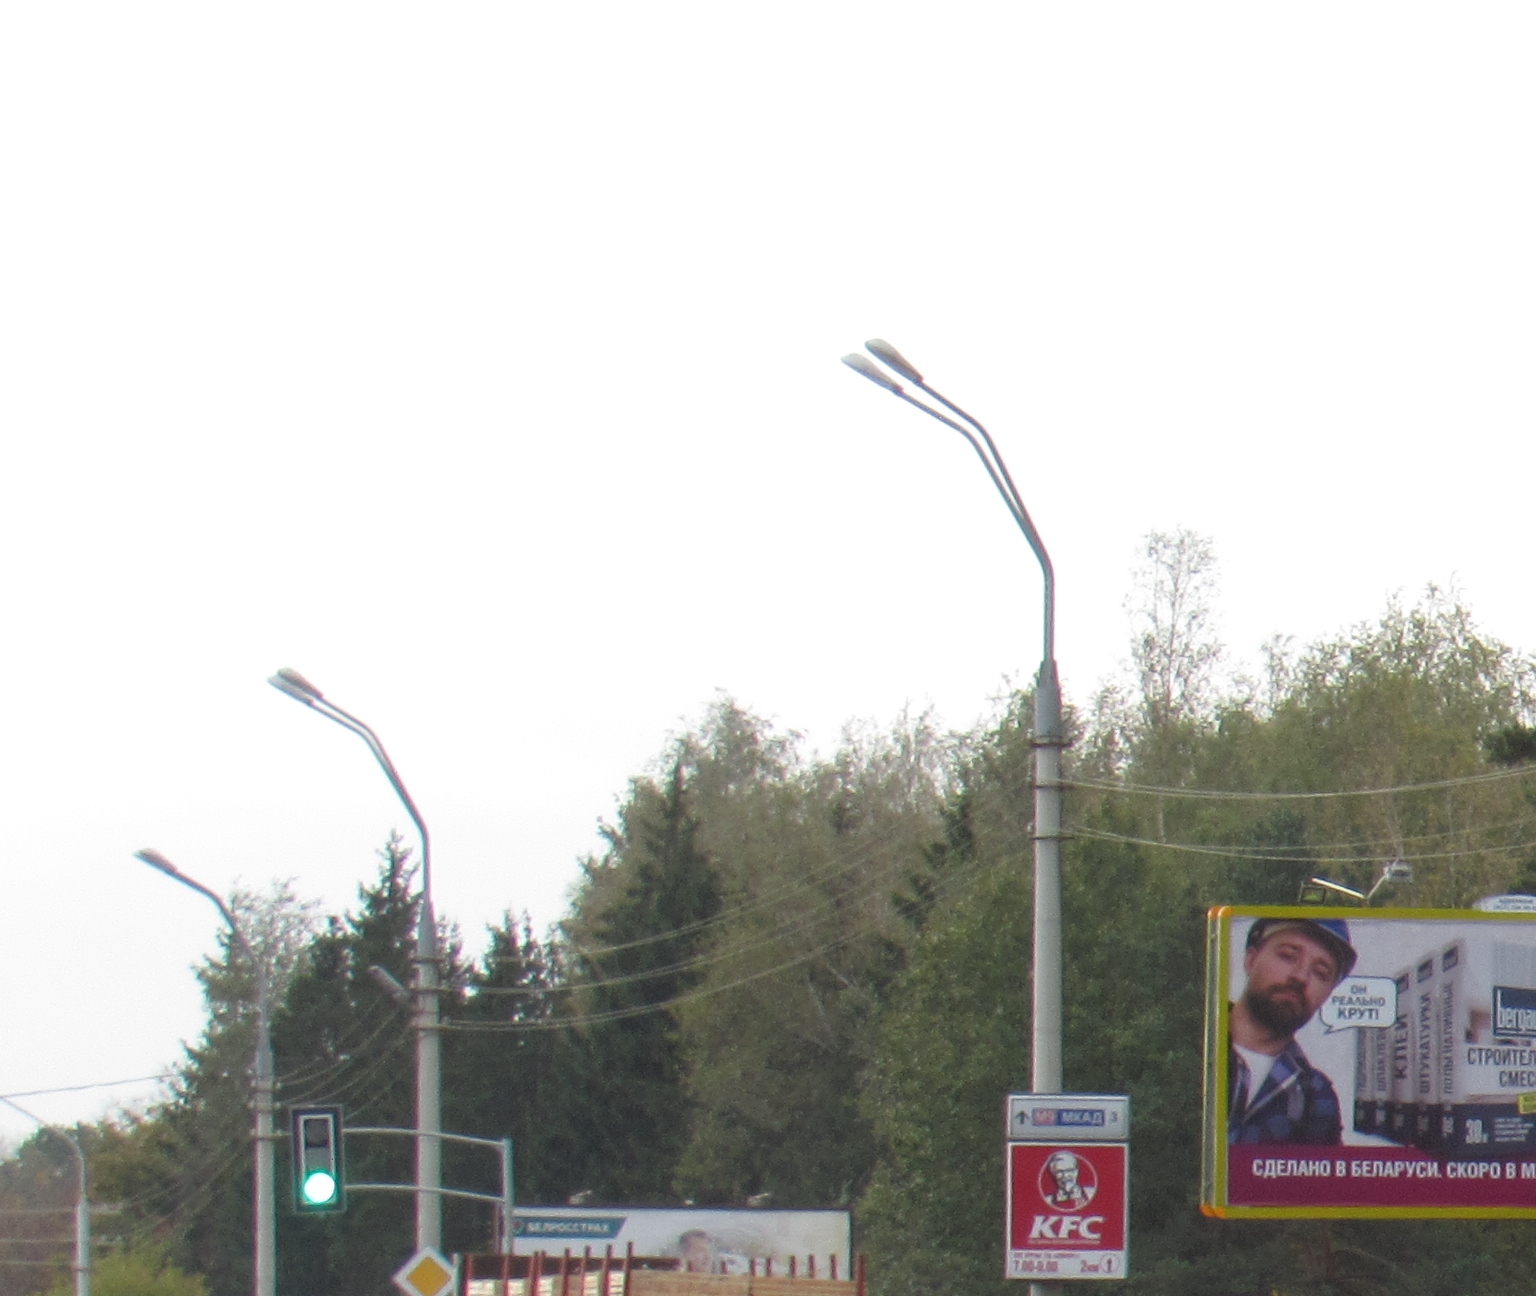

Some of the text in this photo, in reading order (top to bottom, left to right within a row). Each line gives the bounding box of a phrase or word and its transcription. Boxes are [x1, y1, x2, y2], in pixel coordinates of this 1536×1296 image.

[1350, 984, 1367, 994] ОН
[1331, 996, 1387, 1007] РЕАЛЬНО
[1337, 1007, 1379, 1020] КРУТ!
[1252, 1158, 1331, 1179] СДЕЛАНО
[1335, 1159, 1347, 1177] В
[1351, 1159, 1442, 1179] БЕЛАРУСИ.
[1446, 1161, 1501, 1179] СКОРО
[1505, 1162, 1517, 1180] В
[1028, 1215, 1105, 1240] KFC
